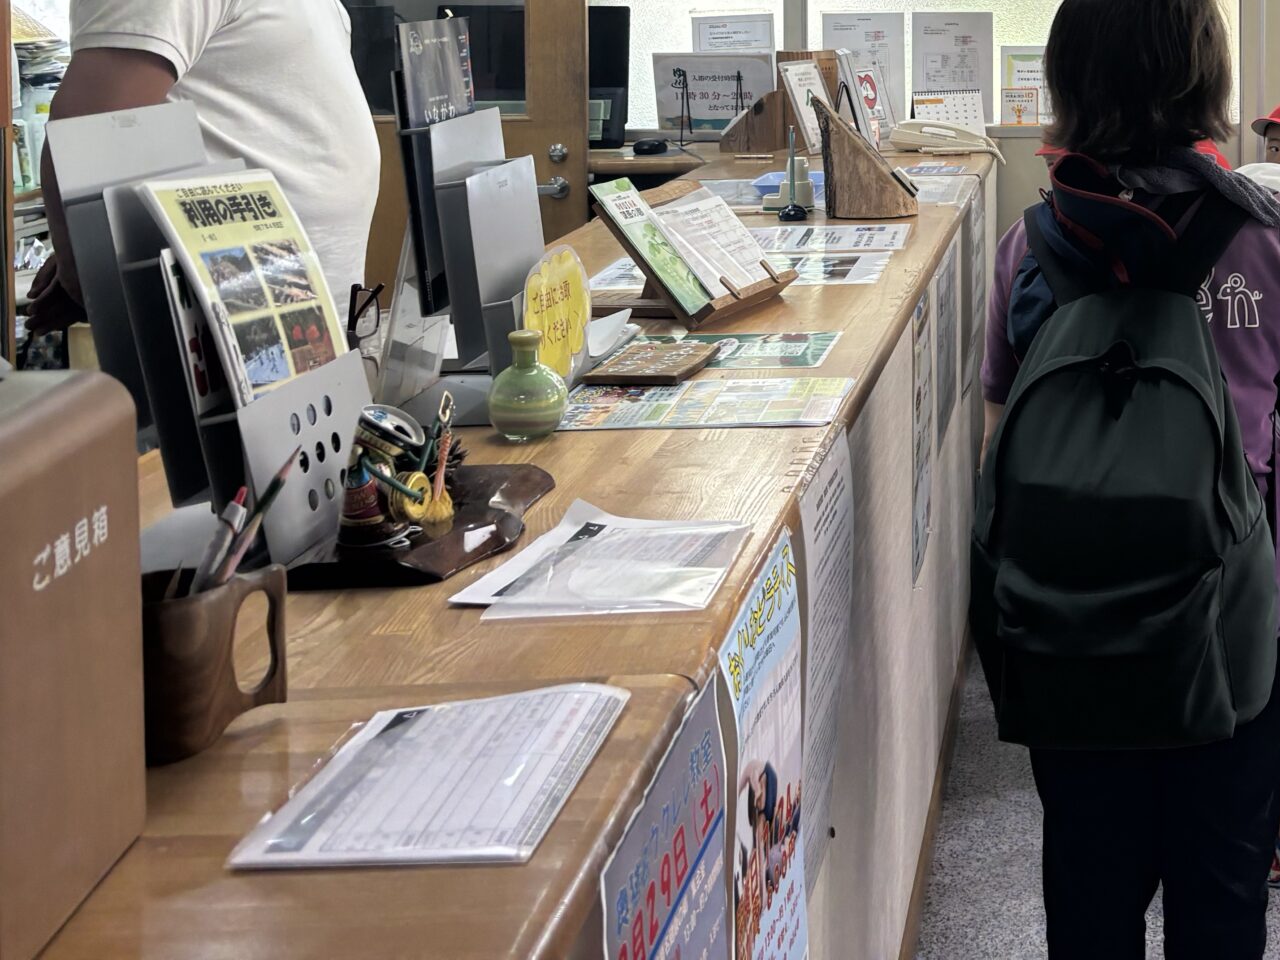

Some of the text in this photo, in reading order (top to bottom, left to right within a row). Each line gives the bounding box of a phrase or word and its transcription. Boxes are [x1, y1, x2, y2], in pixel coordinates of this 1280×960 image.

[424, 101, 456, 123] いながわ
[179, 193, 278, 229] 利用の手引き
[33, 505, 108, 591] ご意見箱
